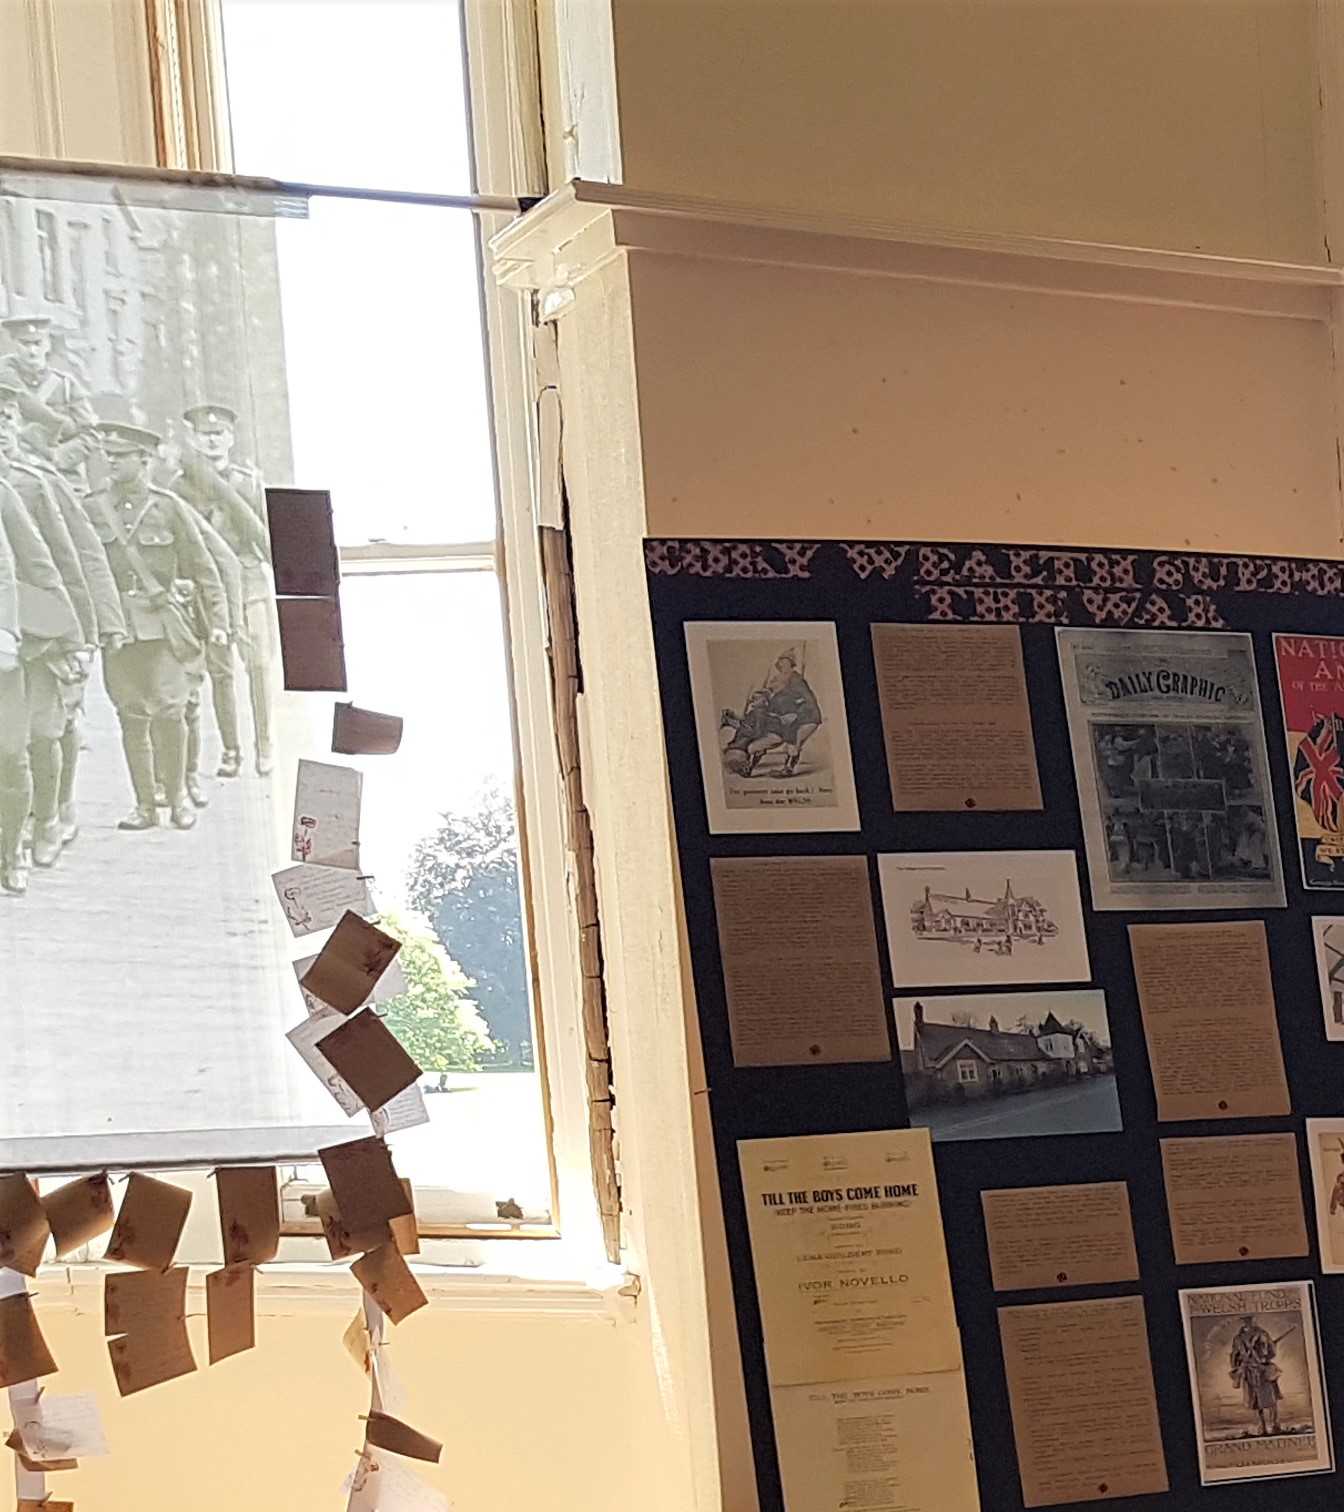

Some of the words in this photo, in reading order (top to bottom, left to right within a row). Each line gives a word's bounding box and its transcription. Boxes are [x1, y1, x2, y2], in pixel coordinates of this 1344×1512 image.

[645, 540, 821, 578] CORY
[839, 543, 1143, 589] WEALTH
[914, 585, 1069, 624] THE
[1082, 589, 1231, 630] WAR
[1105, 671, 1154, 700] DAILY
[1155, 669, 1227, 702] GRAPHIC
[761, 1192, 785, 1206] TILL
[788, 1190, 808, 1204] THE
[813, 1188, 844, 1203] BOYS
[846, 1185, 881, 1201] COME
[884, 1183, 920, 1198] HOME
[798, 1280, 832, 1291] IVOR
[839, 1274, 910, 1289] NOVELLO
[1202, 1302, 1247, 1315] WELSH
